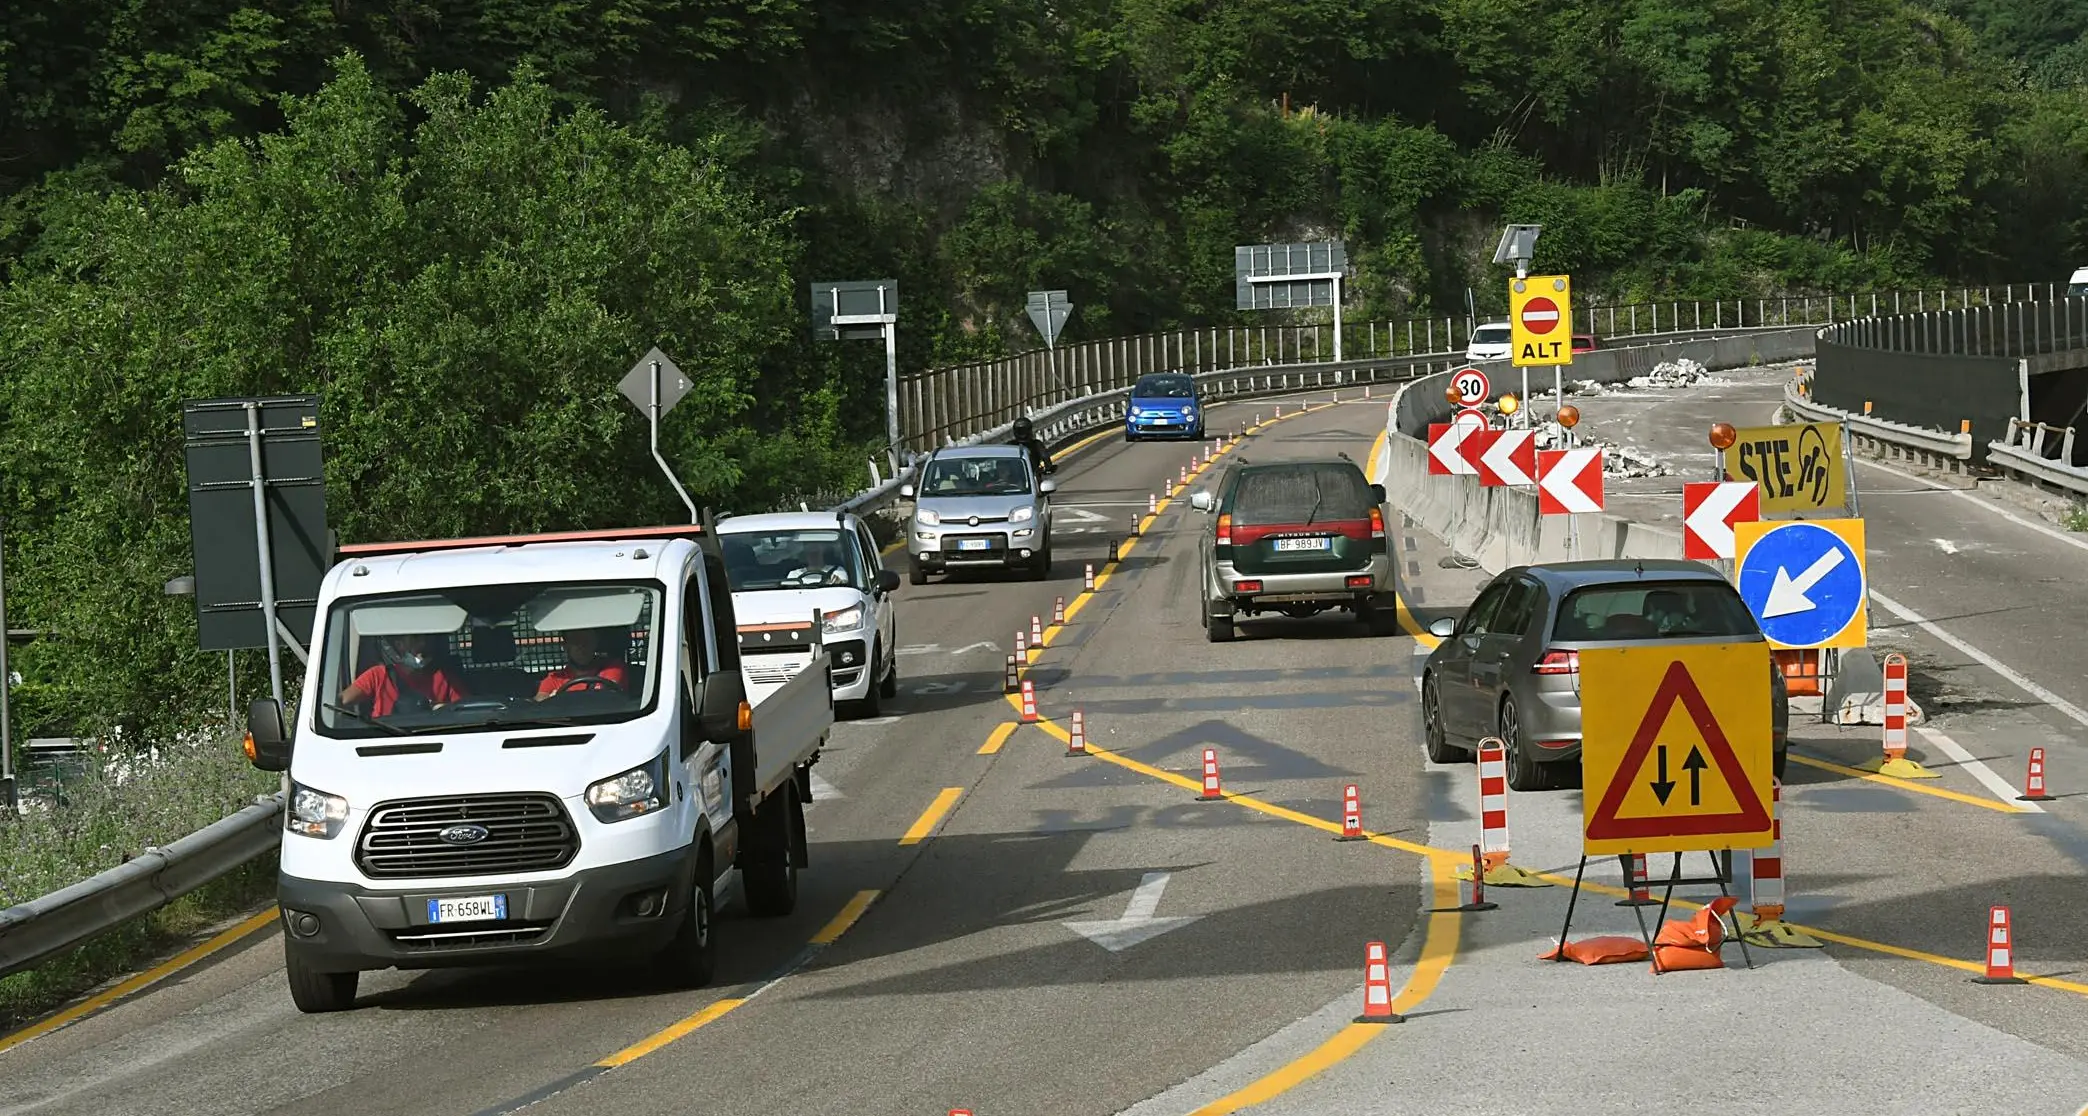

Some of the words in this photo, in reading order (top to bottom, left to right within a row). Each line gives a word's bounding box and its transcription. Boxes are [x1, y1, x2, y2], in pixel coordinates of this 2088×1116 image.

[1522, 342, 1562, 359] ALT
[1460, 380, 1481, 396] 30
[1280, 540, 1292, 549] BF
[440, 903, 454, 918] FR
[457, 901, 494, 917] 658WL
